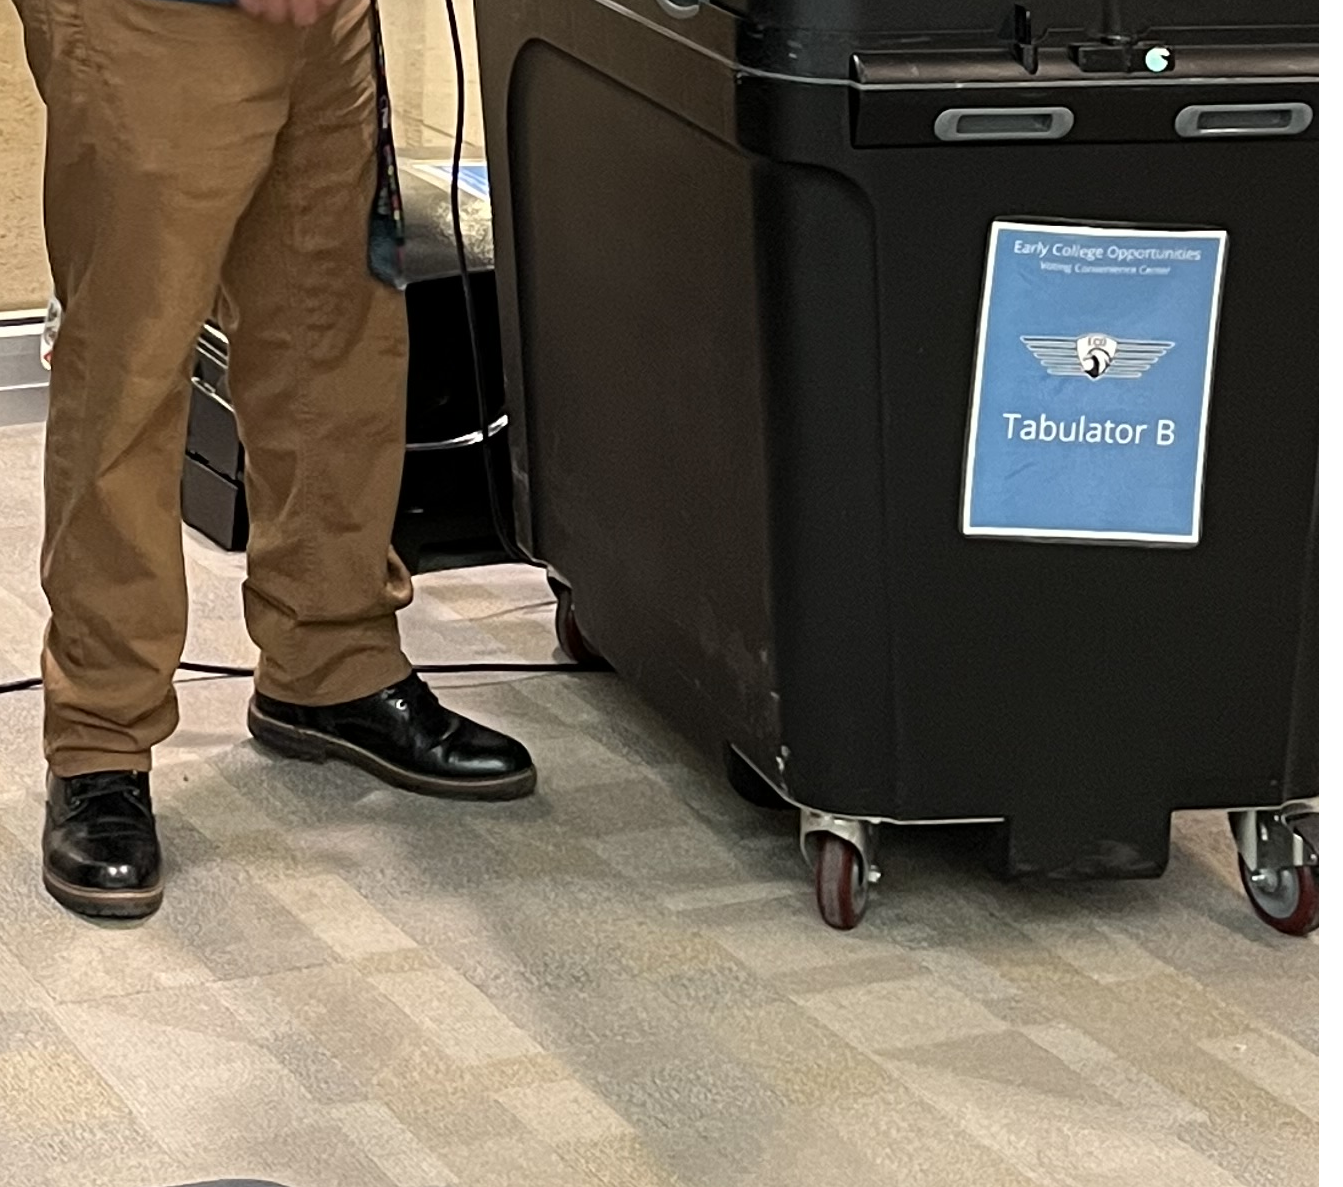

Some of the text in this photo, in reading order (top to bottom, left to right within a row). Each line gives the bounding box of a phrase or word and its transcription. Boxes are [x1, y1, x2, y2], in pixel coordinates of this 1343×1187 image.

[1013, 240, 1202, 262] Early College Opportunities
[1040, 261, 1072, 274] Voting
[1139, 264, 1171, 275] Center
[1002, 412, 1176, 446] Tabulator B
